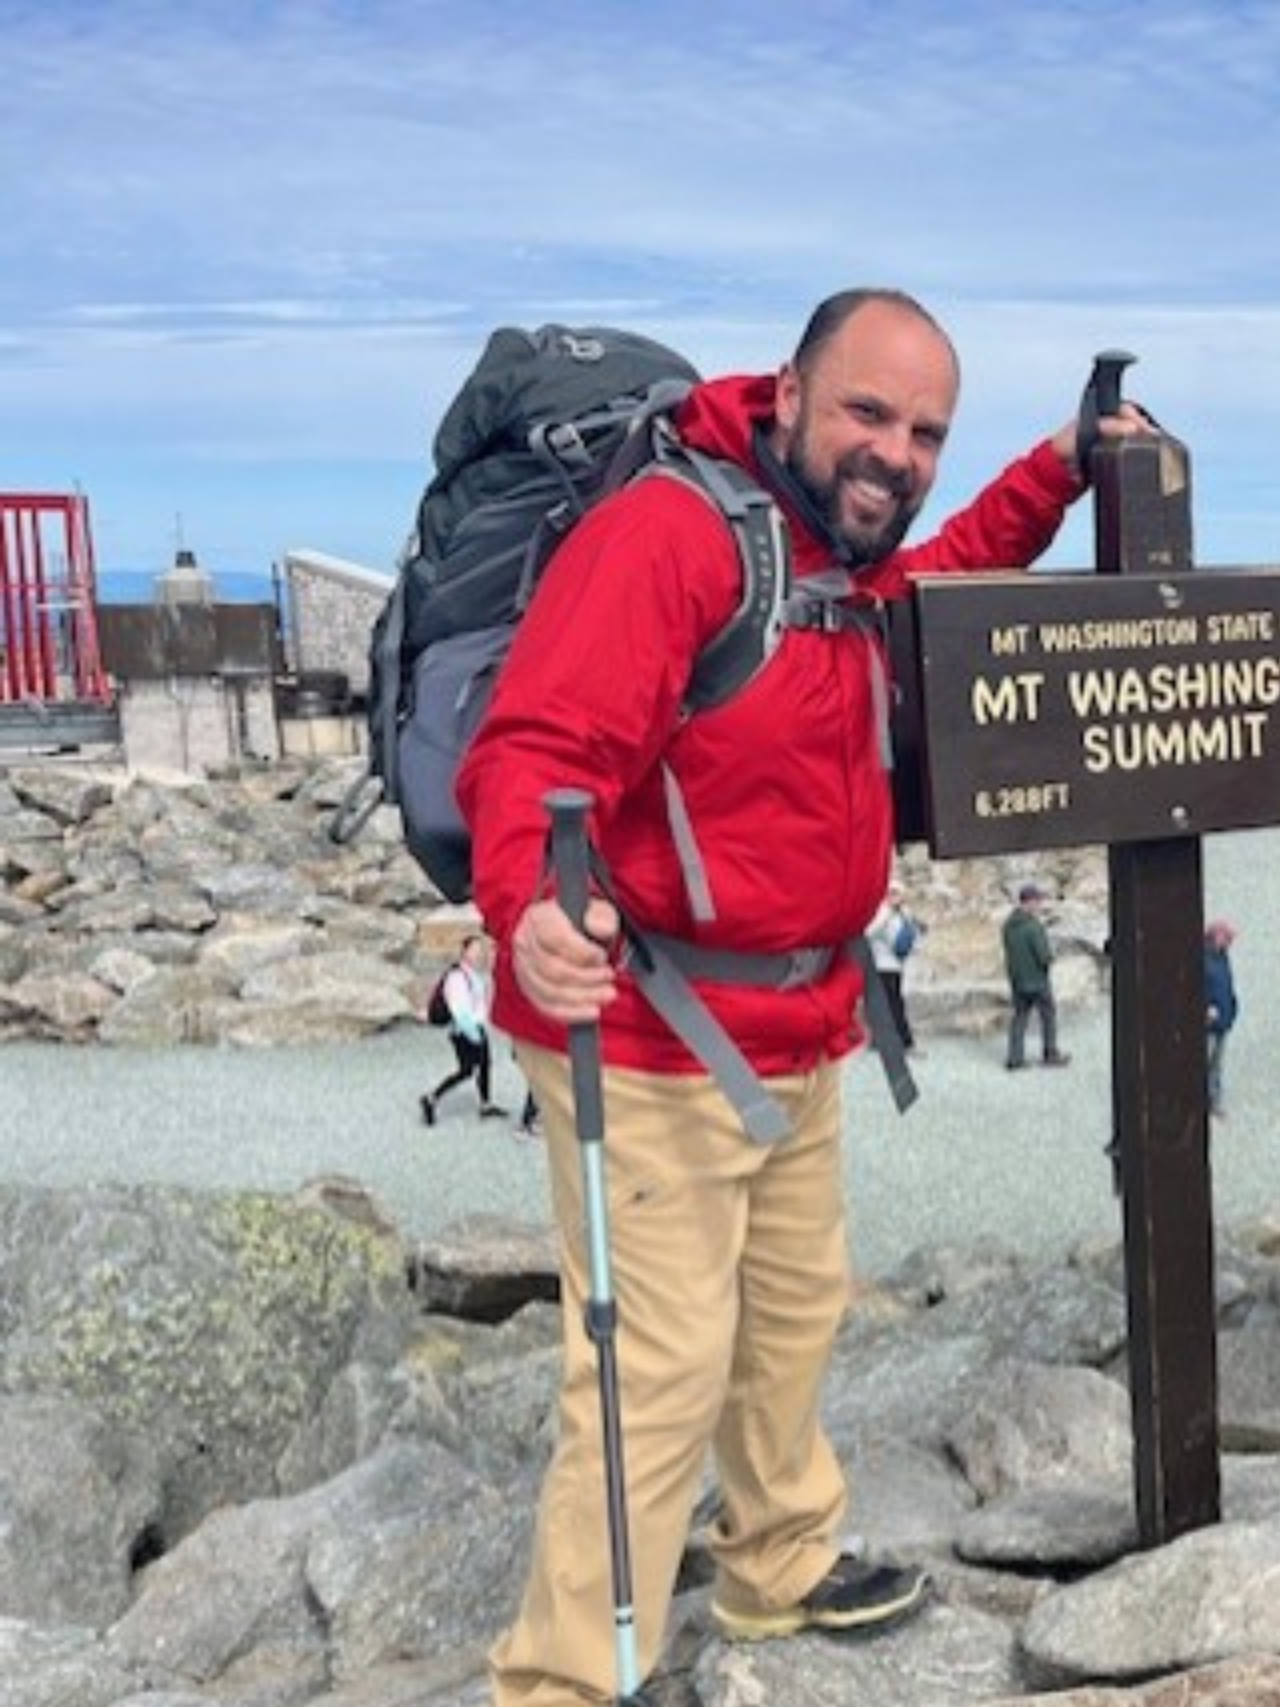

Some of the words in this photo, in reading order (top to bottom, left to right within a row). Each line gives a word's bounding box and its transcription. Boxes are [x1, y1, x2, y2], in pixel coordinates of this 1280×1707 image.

[991, 625, 1029, 655] MT
[1040, 619, 1197, 653] WASHINGTON
[1207, 612, 1273, 643] STATE
[972, 673, 1044, 725] MT
[1082, 712, 1269, 773] SUMMIT
